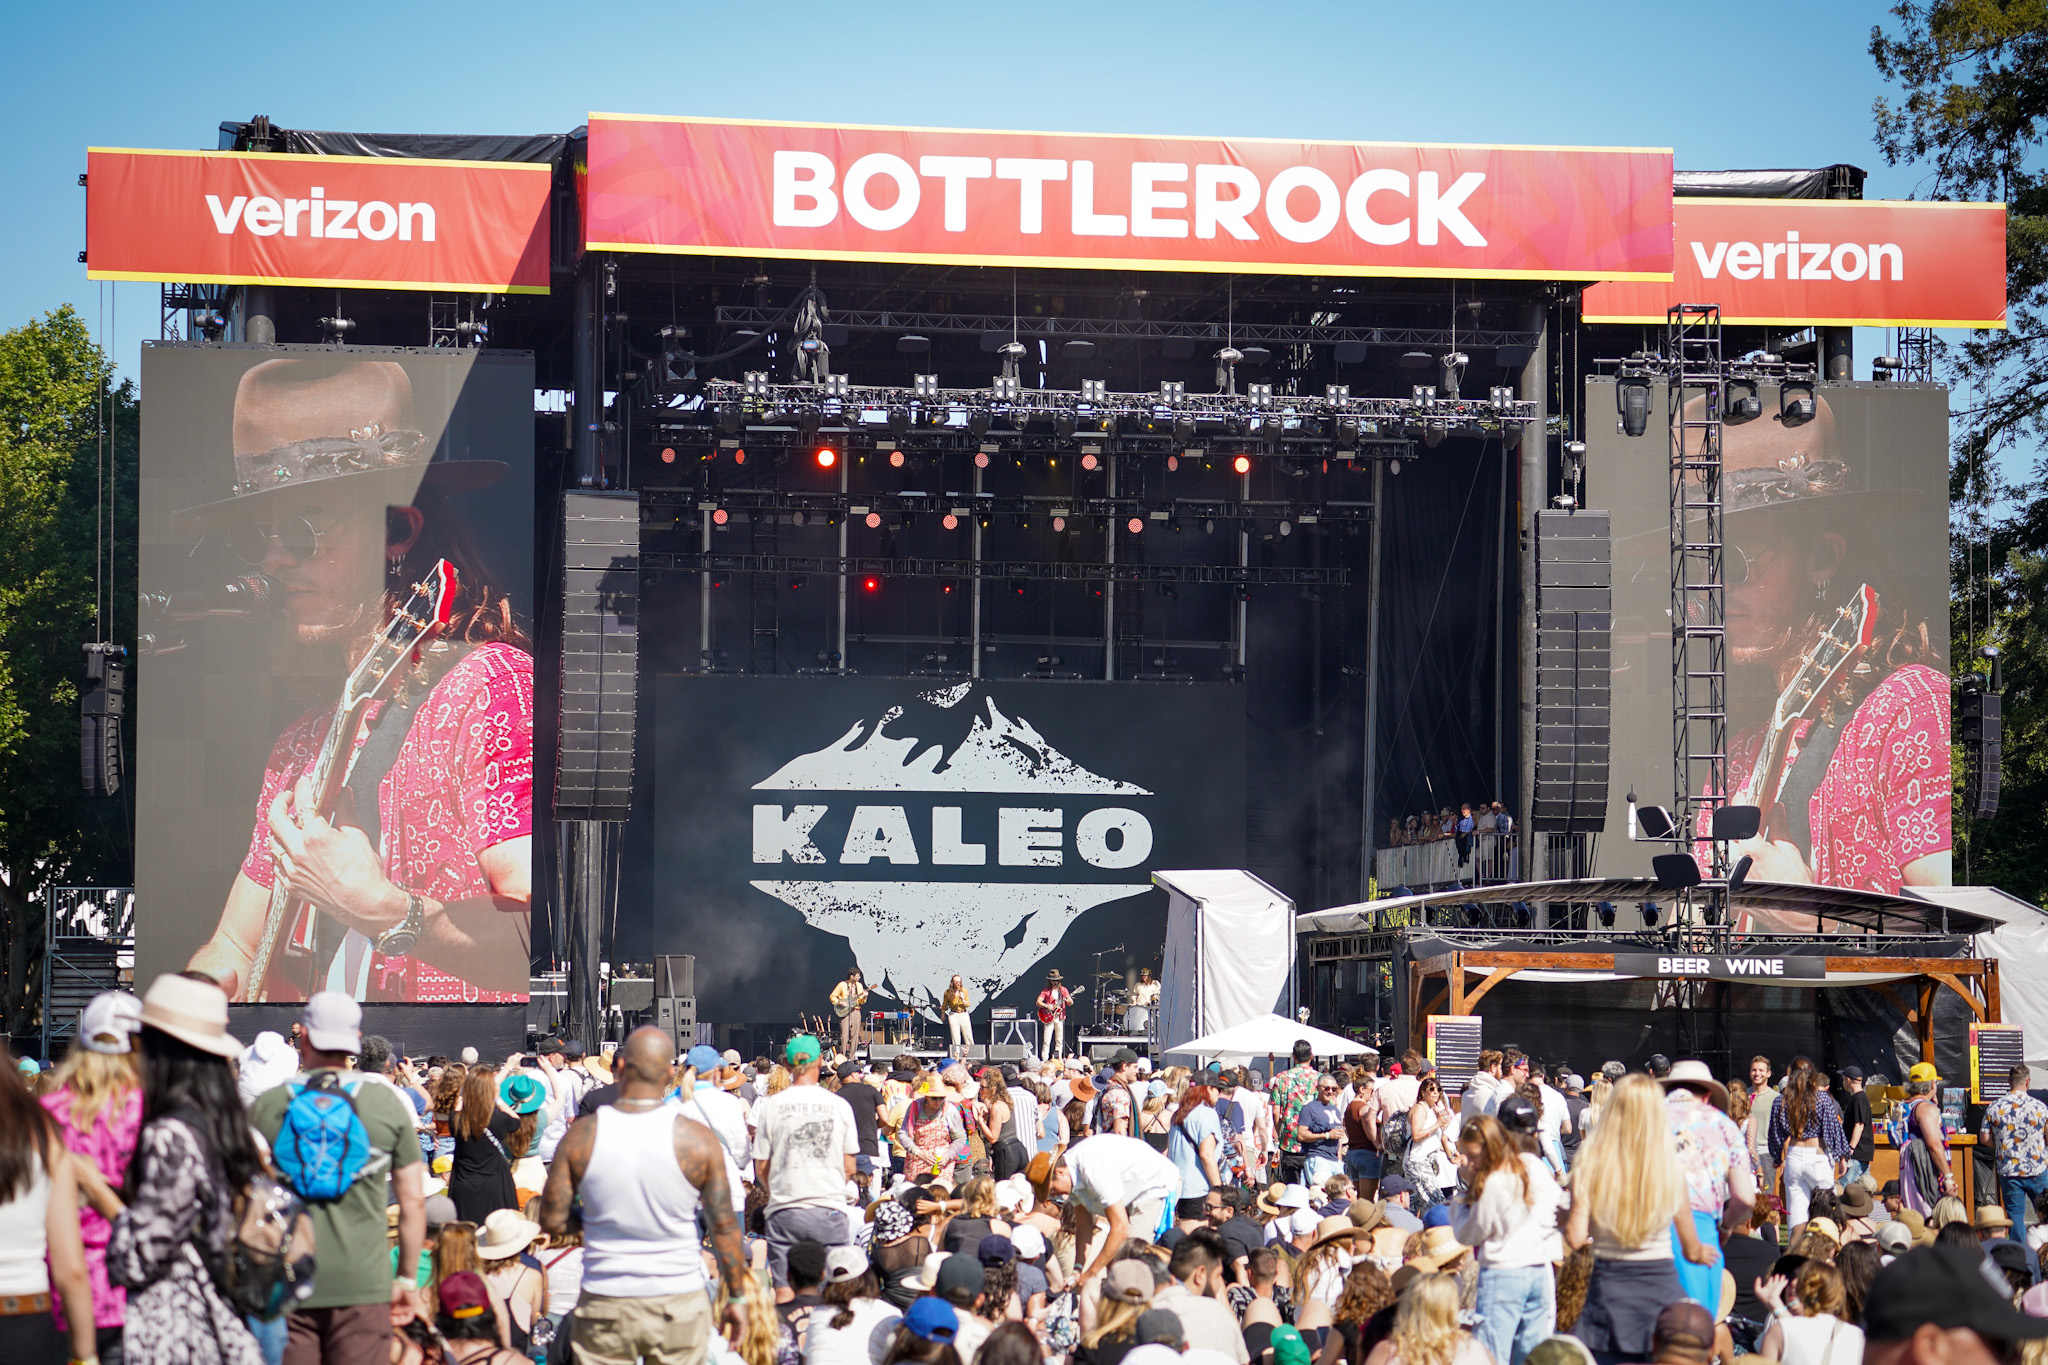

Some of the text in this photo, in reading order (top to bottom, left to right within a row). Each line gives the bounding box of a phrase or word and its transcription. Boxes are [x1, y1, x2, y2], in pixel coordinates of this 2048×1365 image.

[205, 186, 436, 242] verizon
[772, 149, 1489, 248] BOTTLEROCK
[1689, 230, 1904, 282] verizon
[752, 804, 1155, 869] KALEO
[1658, 957, 1784, 975] BEER WINE
[778, 1103, 835, 1115] SANTA CRUZ
